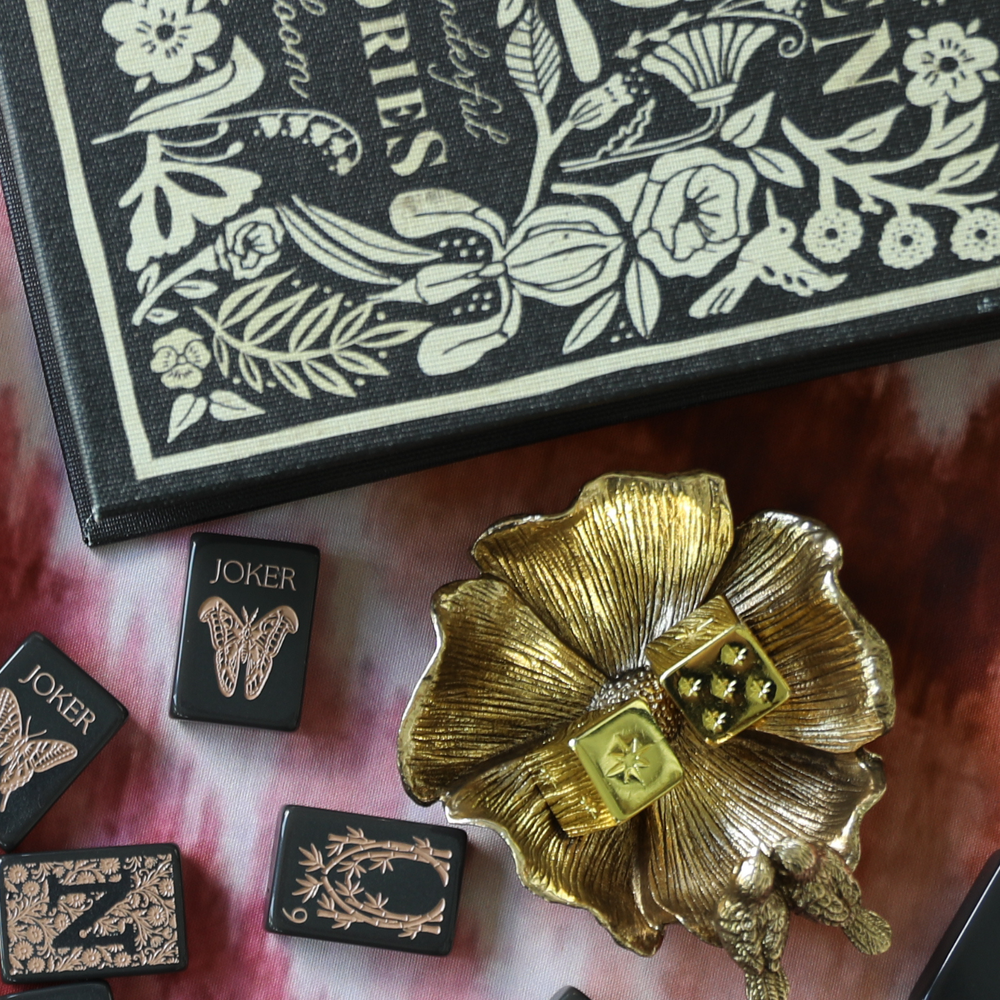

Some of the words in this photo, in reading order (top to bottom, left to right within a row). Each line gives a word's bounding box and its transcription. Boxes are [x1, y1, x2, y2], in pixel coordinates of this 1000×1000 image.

[355, 0, 448, 177] RIES
[209, 558, 297, 591] JOKER
[18, 664, 96, 735] JOKER
